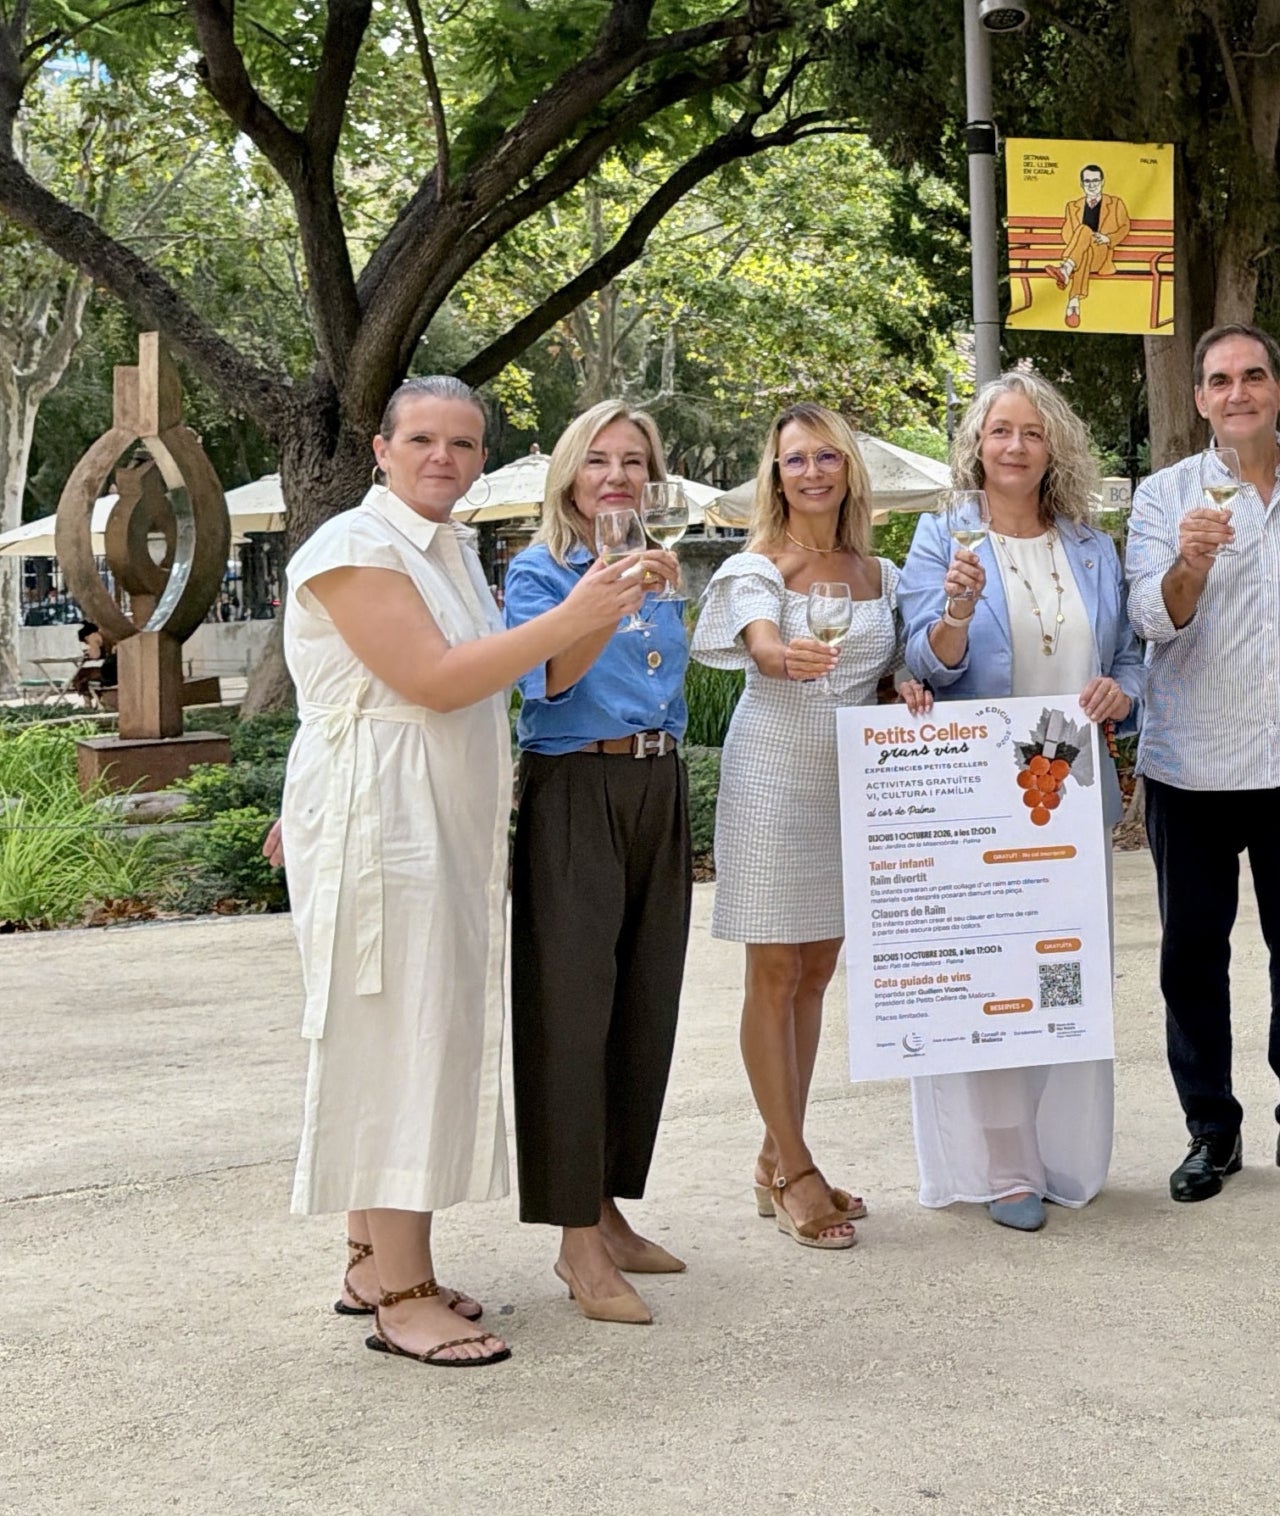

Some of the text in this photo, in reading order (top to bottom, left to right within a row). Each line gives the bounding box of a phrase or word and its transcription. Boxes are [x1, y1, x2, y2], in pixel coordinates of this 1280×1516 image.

[864, 722, 988, 746] Petits Cellers
[878, 742, 969, 764] grans vins
[864, 765, 922, 774] EXPERIÈNCIES
[866, 776, 982, 790] ACTIVITATS GRATUÏTES
[866, 792, 880, 801] VI,
[882, 790, 928, 800] CULTURA
[935, 786, 974, 796] FAMÍLIA
[868, 834, 894, 843] DIJOUS
[870, 858, 934, 872] Taller infantil
[870, 872, 927, 886] Raïm divertit
[871, 906, 946, 920] Clauers de Raïm
[873, 954, 898, 963] DIJOUS
[874, 972, 972, 989] Cata guiada de vins
